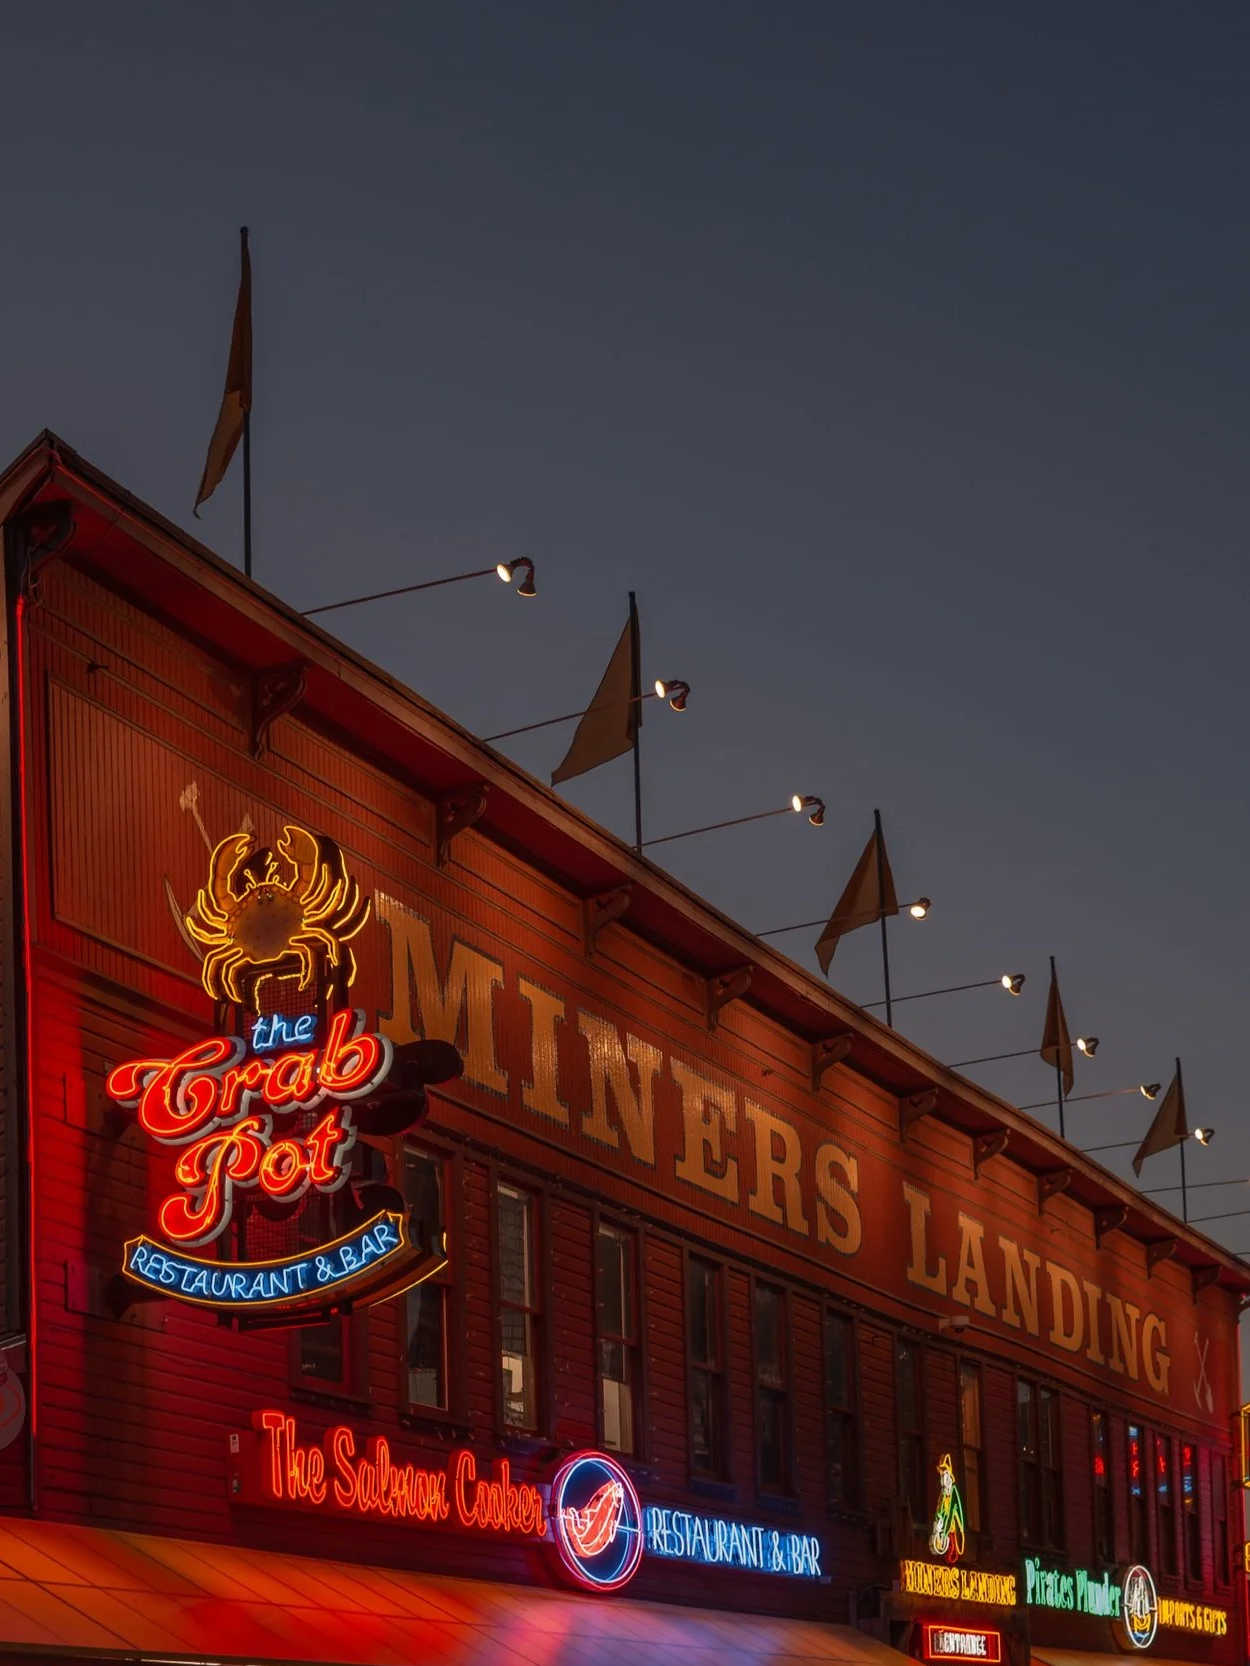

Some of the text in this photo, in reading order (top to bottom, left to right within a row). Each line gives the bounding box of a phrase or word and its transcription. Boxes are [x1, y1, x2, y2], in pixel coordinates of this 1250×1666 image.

[252, 1013, 314, 1050] the
[106, 1008, 388, 1137] Crab
[158, 1105, 350, 1241] Pot
[374, 889, 1171, 1399] MINERS LANDING
[130, 1221, 399, 1299] RESTAURANT & BAR
[260, 1410, 548, 1537] The Salmon Cooker
[651, 1507, 823, 1578] RESTAURANT & BAR
[905, 1560, 1017, 1606] MINERS LANDING
[1024, 1557, 1122, 1617] Pirates Plunder
[940, 1631, 987, 1656] ENTRANCE
